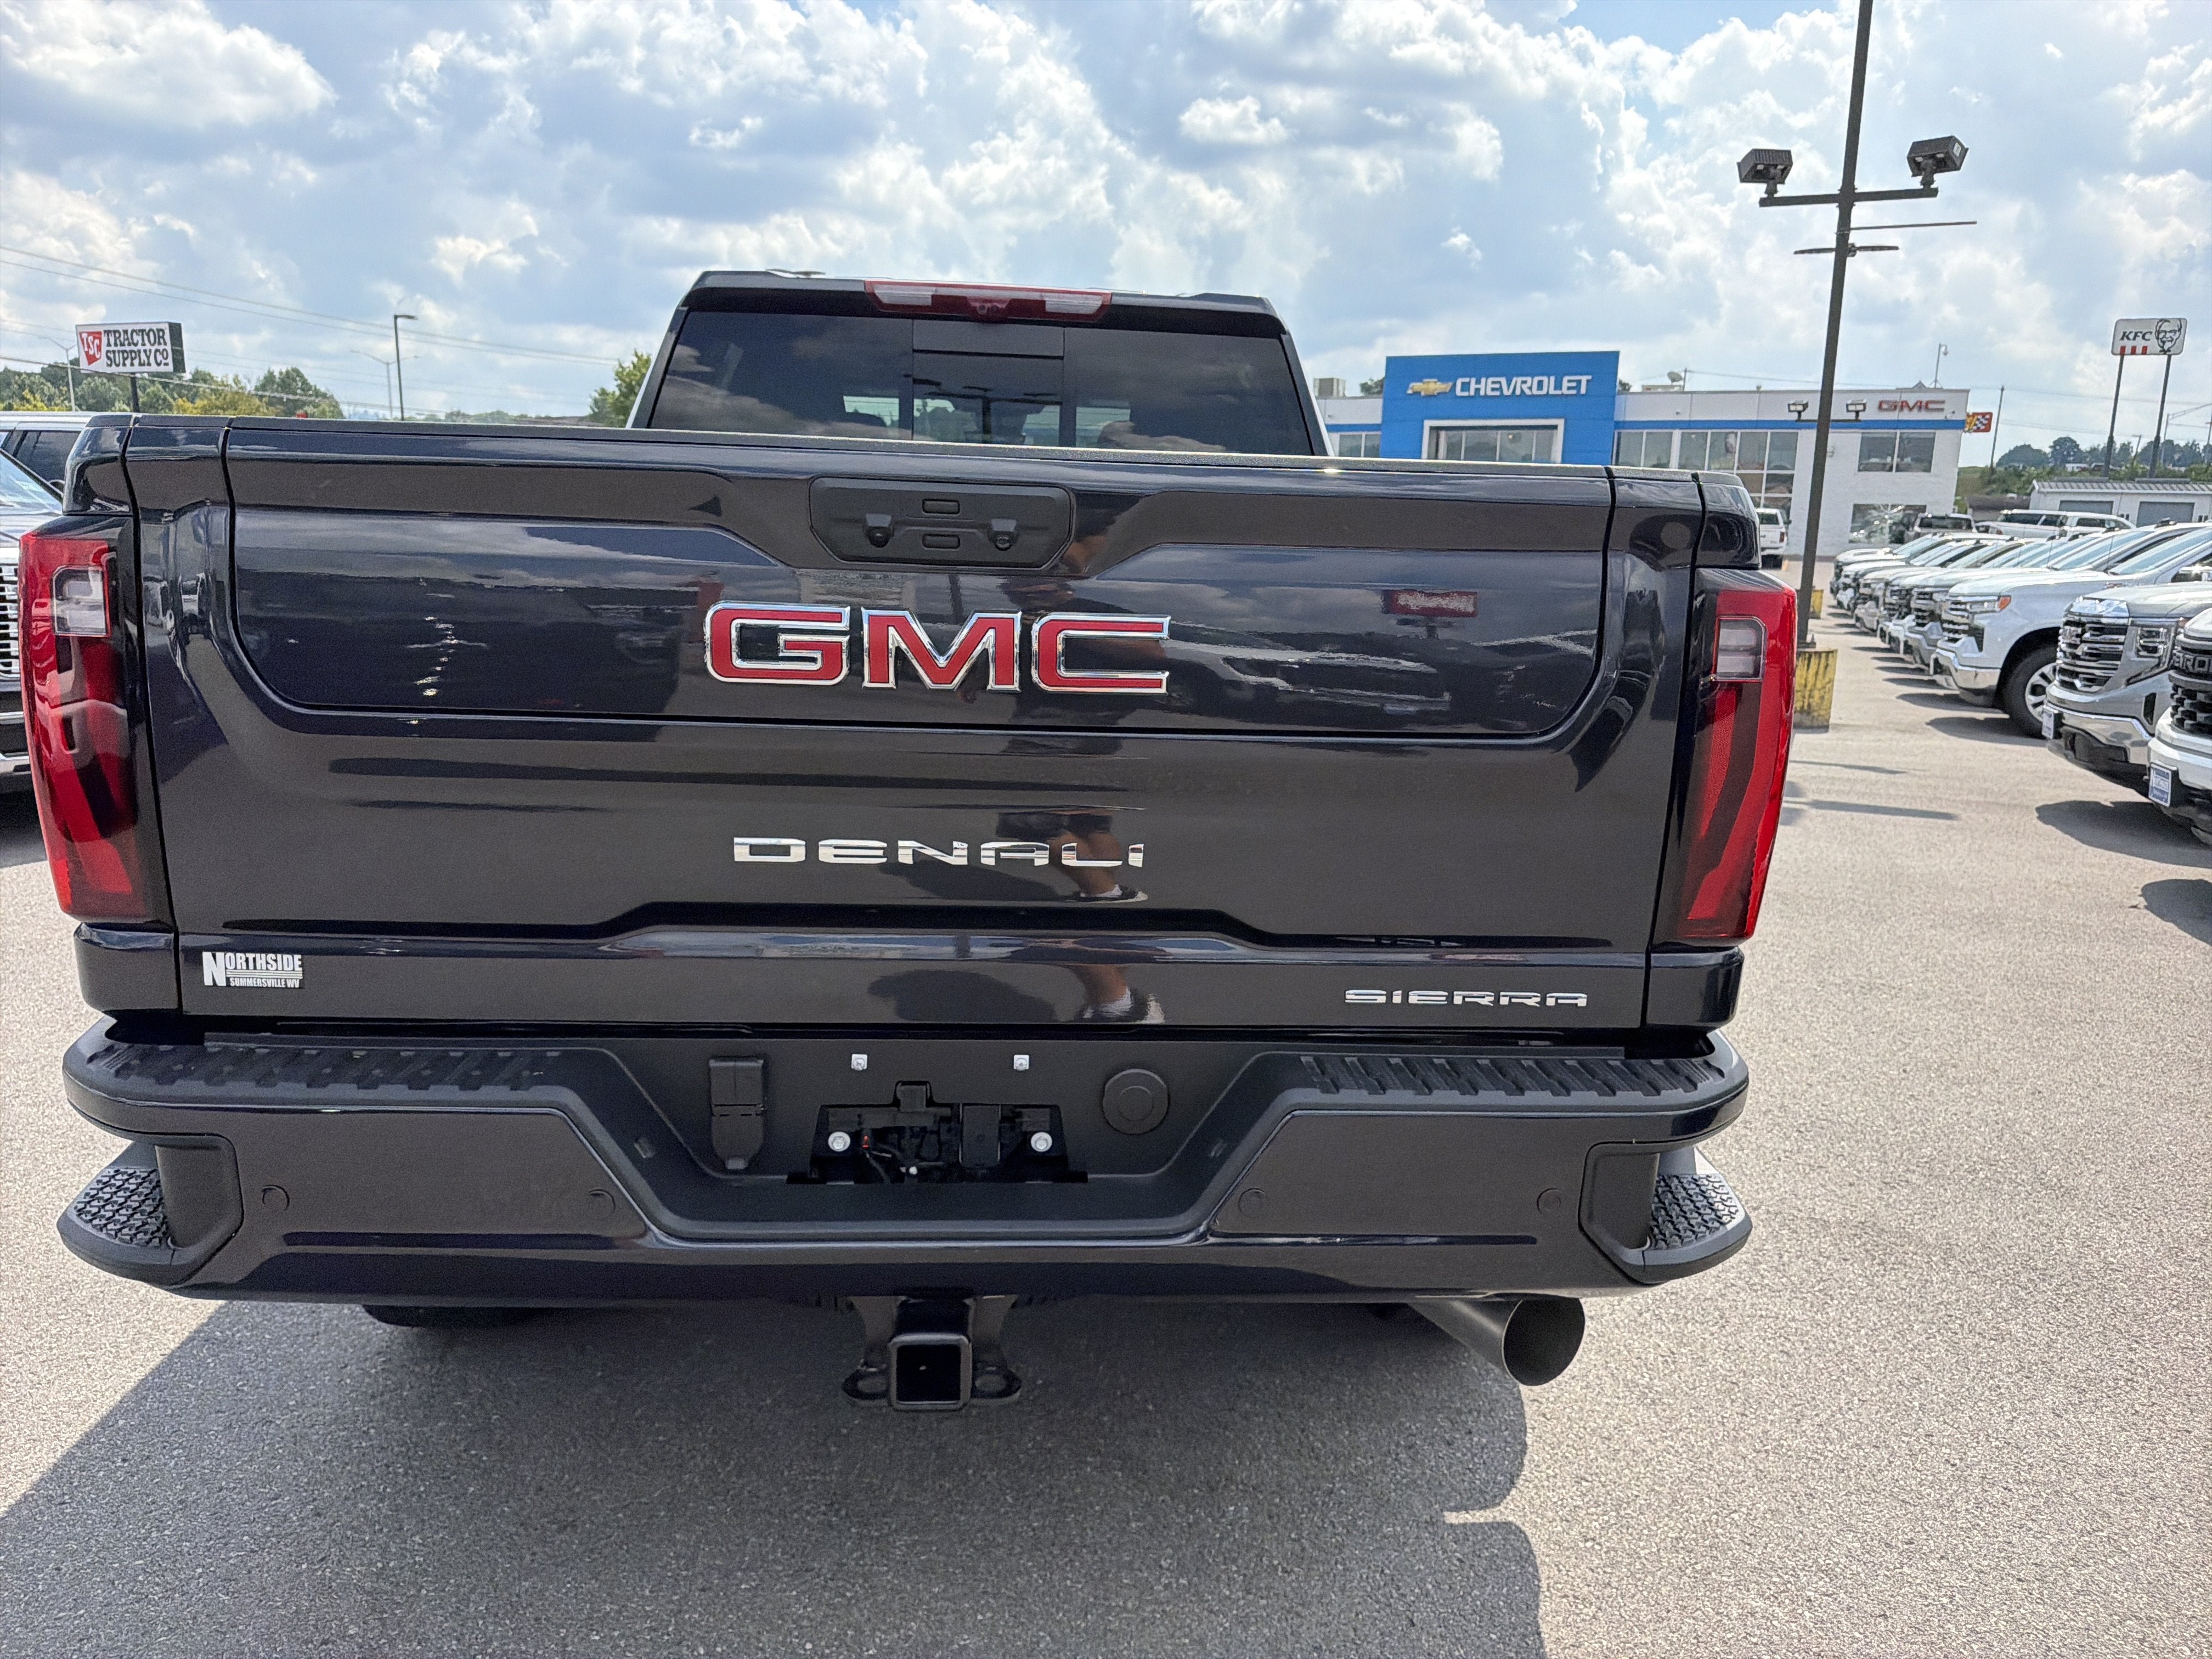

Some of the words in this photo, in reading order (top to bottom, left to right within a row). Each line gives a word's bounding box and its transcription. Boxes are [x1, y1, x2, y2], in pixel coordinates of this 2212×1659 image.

[82, 332, 101, 359] TSC
[103, 328, 167, 347] TRACTOR
[2120, 331, 2153, 341] KFC
[105, 349, 152, 368] SUPPLY
[1455, 375, 1592, 397] CHEVROLET
[1878, 400, 1946, 412] GMC
[703, 600, 1171, 695] GMC
[733, 837, 1144, 867] DENALI
[202, 952, 303, 986] NORTHSIDE
[229, 978, 286, 988] SUMMERSVILLE
[286, 979, 300, 988] WV
[1345, 990, 1587, 1007] SIERRA
